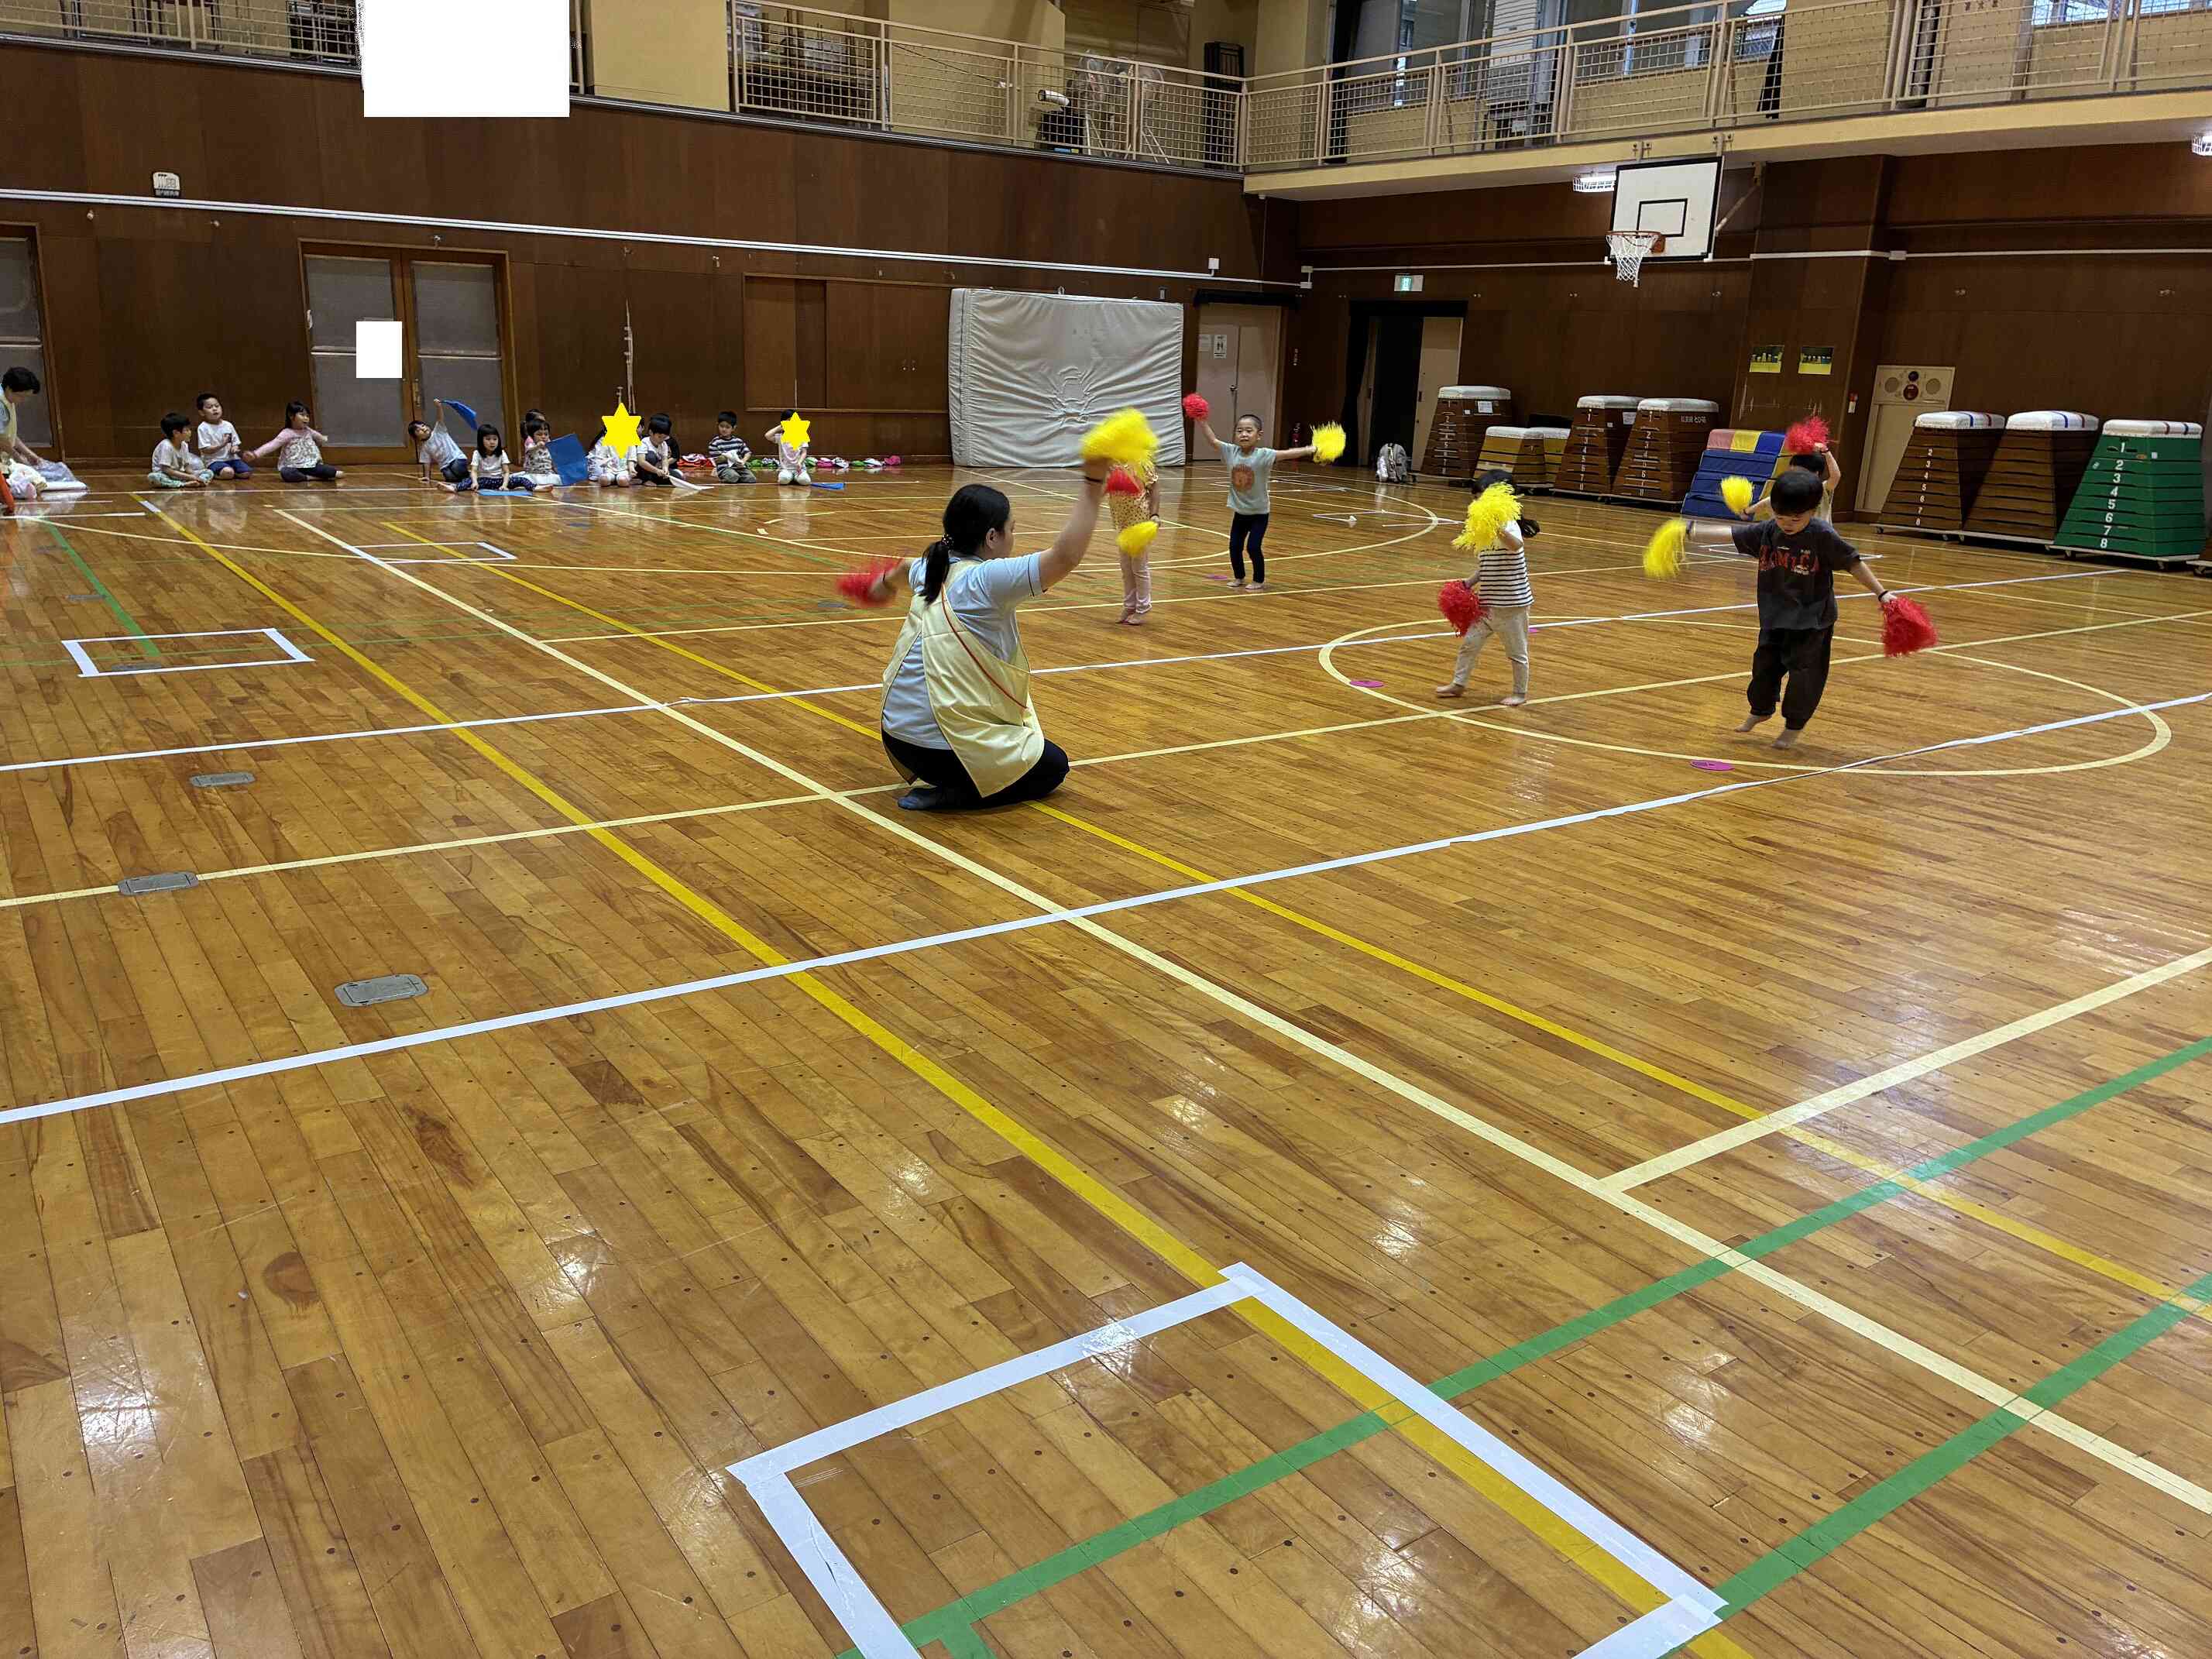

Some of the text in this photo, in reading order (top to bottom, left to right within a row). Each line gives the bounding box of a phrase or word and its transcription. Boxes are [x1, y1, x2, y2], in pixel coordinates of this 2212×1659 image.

[2121, 442, 2126, 453] 1
[2115, 459, 2124, 471] 2
[1924, 472, 1929, 480] 4
[2113, 472, 2121, 483] 3
[2110, 486, 2119, 497] 4
[2107, 499, 2116, 510] 5
[2105, 512, 2114, 523] 6
[2104, 525, 2112, 535] 7
[2100, 538, 2108, 548] 8
